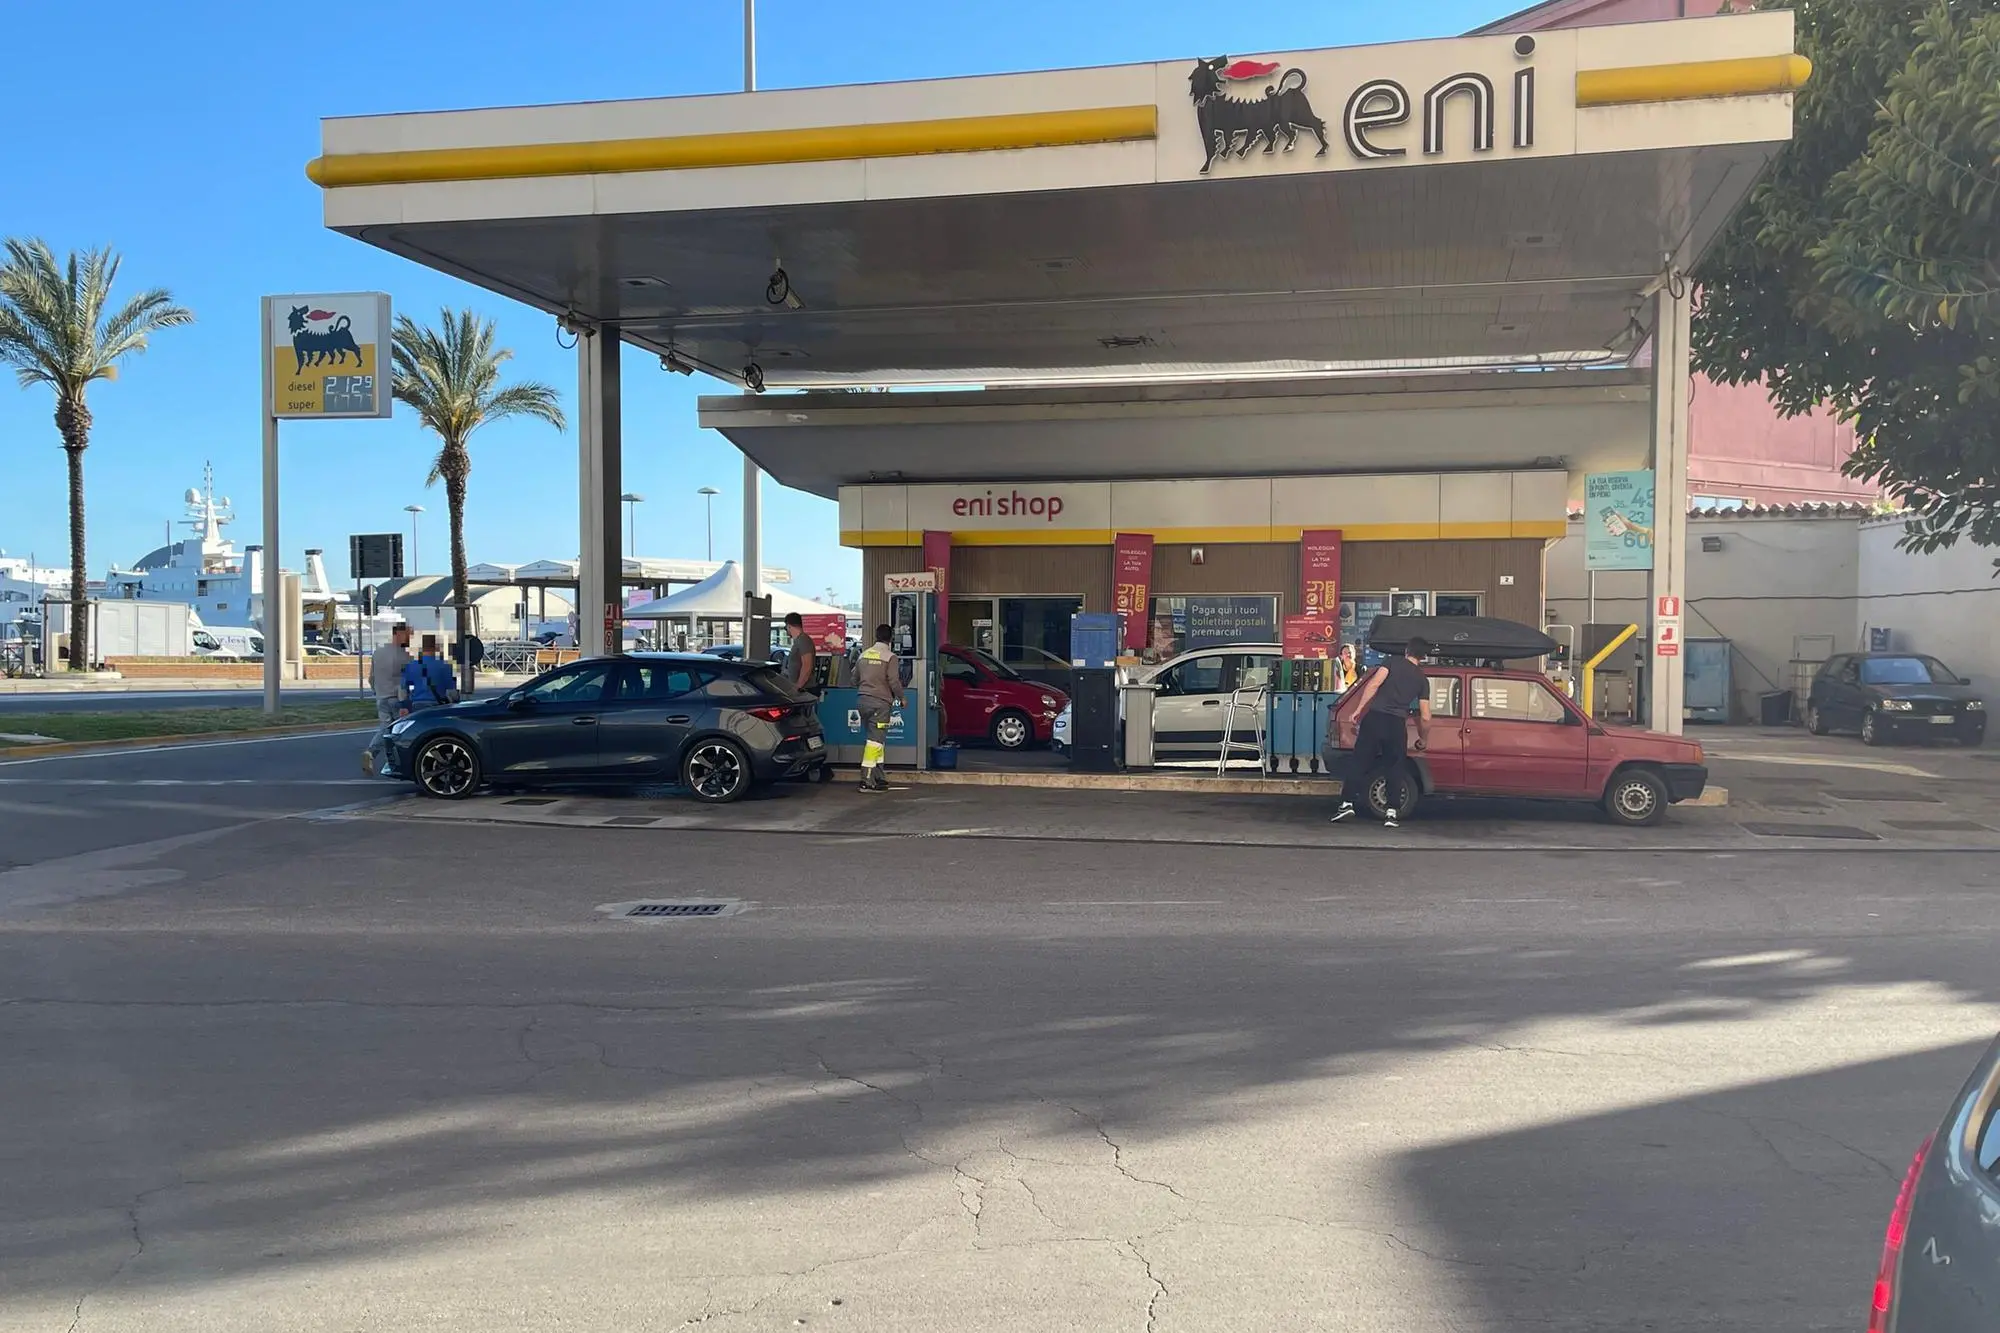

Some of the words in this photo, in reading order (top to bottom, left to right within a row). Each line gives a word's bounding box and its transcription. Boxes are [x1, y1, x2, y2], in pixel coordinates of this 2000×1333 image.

[1343, 34, 1536, 159] eni
[288, 381, 316, 391] diesel
[288, 400, 315, 411] super
[1624, 532, 1649, 549] 60
[901, 577, 917, 588] 24
[918, 579, 933, 587] ore
[1191, 604, 1215, 616] Paga
[1217, 606, 1233, 616] qui
[1240, 606, 1259, 614] tuoi
[1191, 617, 1233, 626] bollettini
[1234, 617, 1267, 629] postali
[1191, 628, 1242, 638] premarcati
